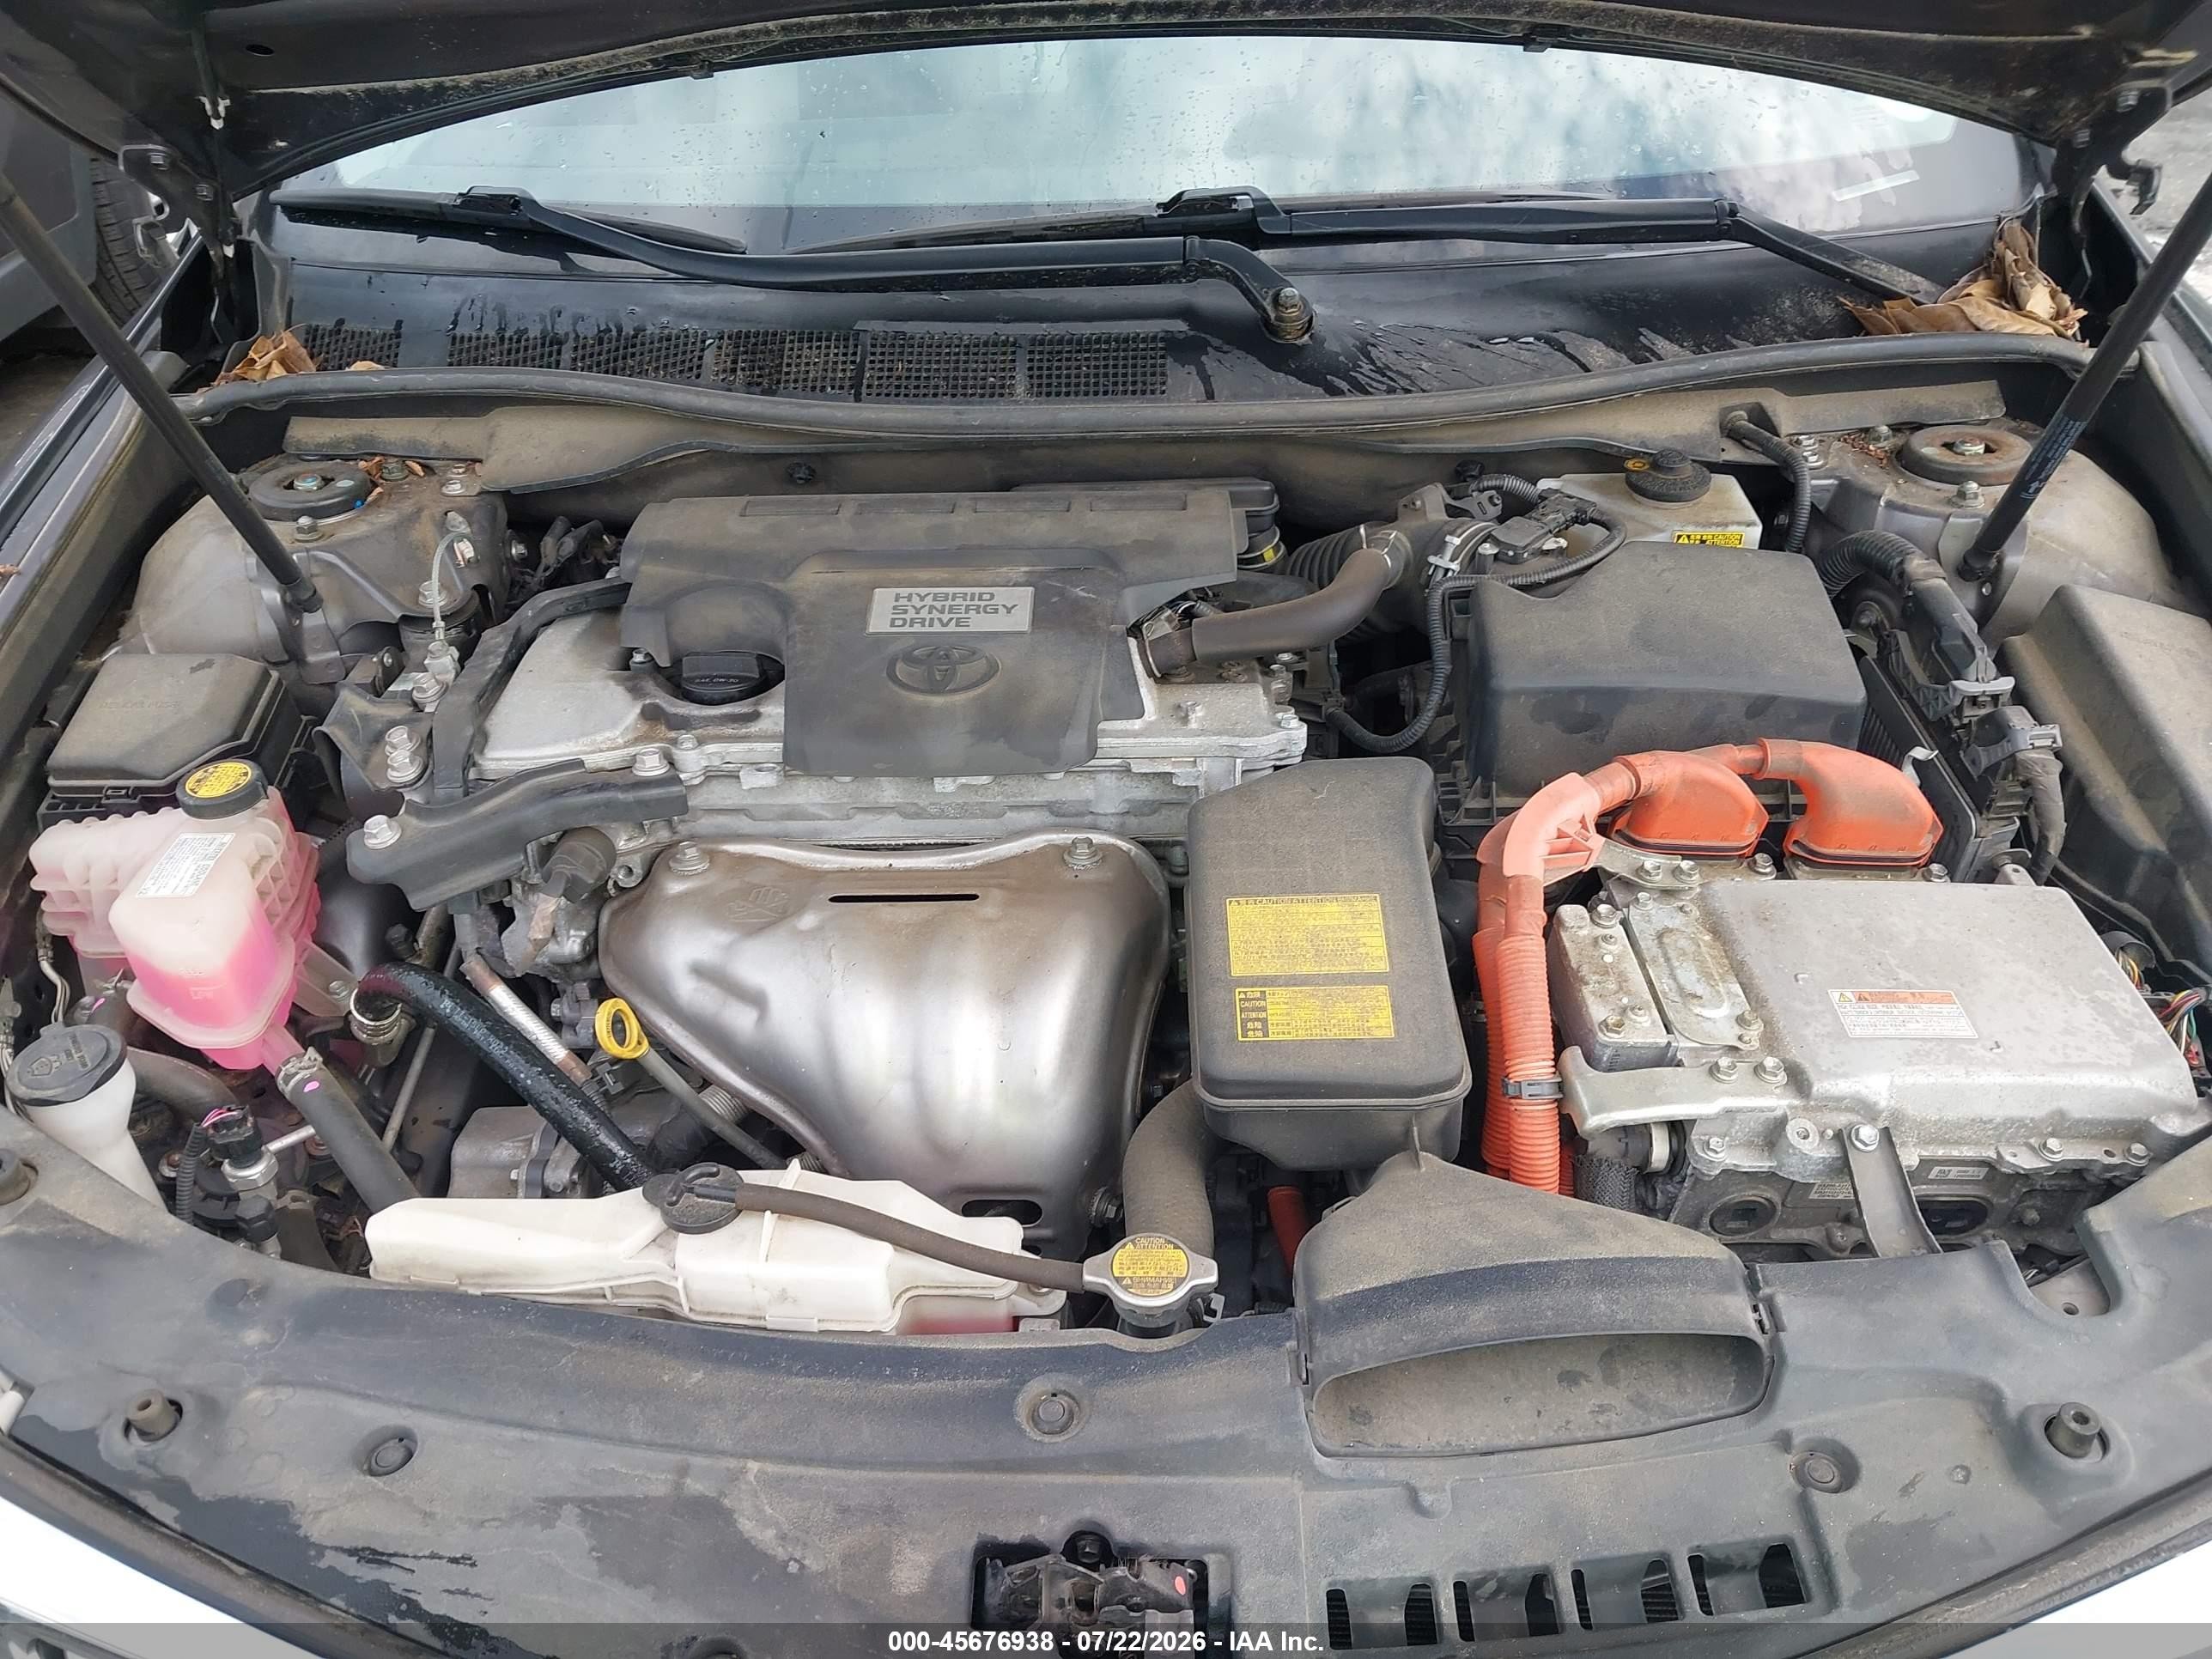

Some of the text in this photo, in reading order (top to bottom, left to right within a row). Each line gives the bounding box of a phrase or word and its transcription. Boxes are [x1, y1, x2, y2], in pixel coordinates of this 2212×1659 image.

[894, 592, 995, 602] HYBRID
[891, 605, 1018, 615] SYNERGY
[890, 617, 971, 628] DRIVE
